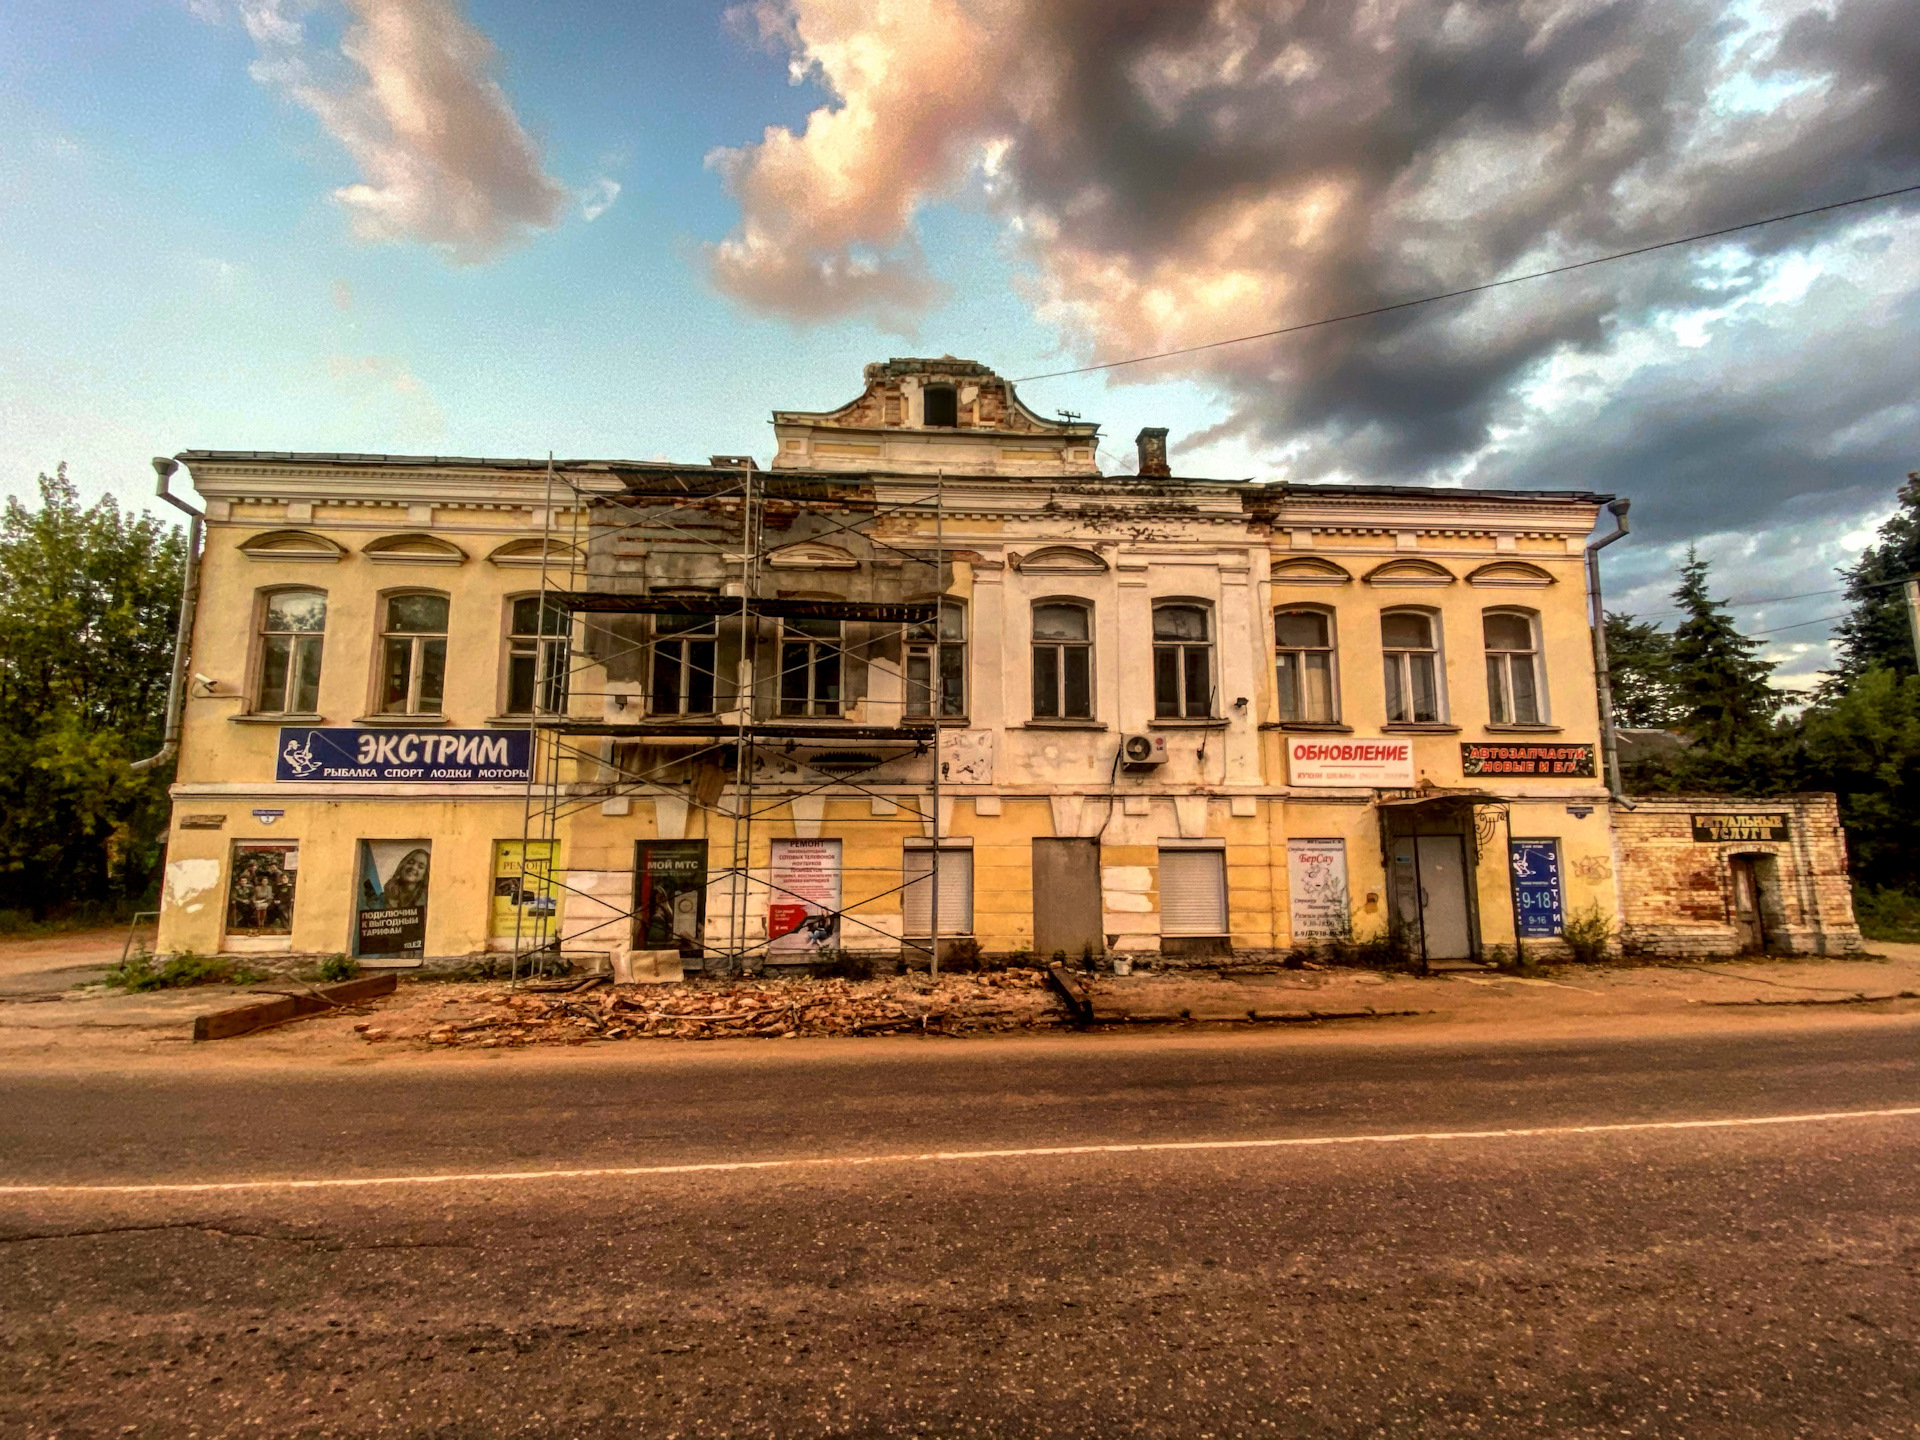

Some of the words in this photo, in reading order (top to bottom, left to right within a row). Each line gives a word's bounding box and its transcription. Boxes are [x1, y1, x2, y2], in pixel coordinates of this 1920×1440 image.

[357, 733, 509, 766] ЭКСТРИМ
[1293, 744, 1409, 761] ОБНОВЛЕНИЕ
[1469, 748, 1585, 759] АВТОЗАПЧАСТИ
[1481, 761, 1535, 772] НОВЫЕ
[1539, 762, 1549, 772] И
[1553, 762, 1576, 773] Б/У
[323, 768, 378, 778] РЫБАЛКА
[384, 768, 423, 778] СПОРТ
[430, 769, 472, 779] ЛОДКИ
[477, 769, 529, 779] МОТОРЫ
[1695, 816, 1784, 828] РИТУАЛЬНЫЕ
[1710, 827, 1772, 840] УСЛУГИ
[790, 840, 825, 848] РЕМОНТ
[647, 860, 672, 870] МОЙ
[674, 861, 699, 869] МТС
[1299, 854, 1334, 865] БерСау
[1522, 892, 1551, 909] 9-18
[361, 909, 418, 919] ПОДКЛЮЧИМ
[369, 917, 419, 928] ВЫГОДНЫМ
[1528, 916, 1547, 924] 9-16
[362, 927, 402, 937] ТАРИФАМ
